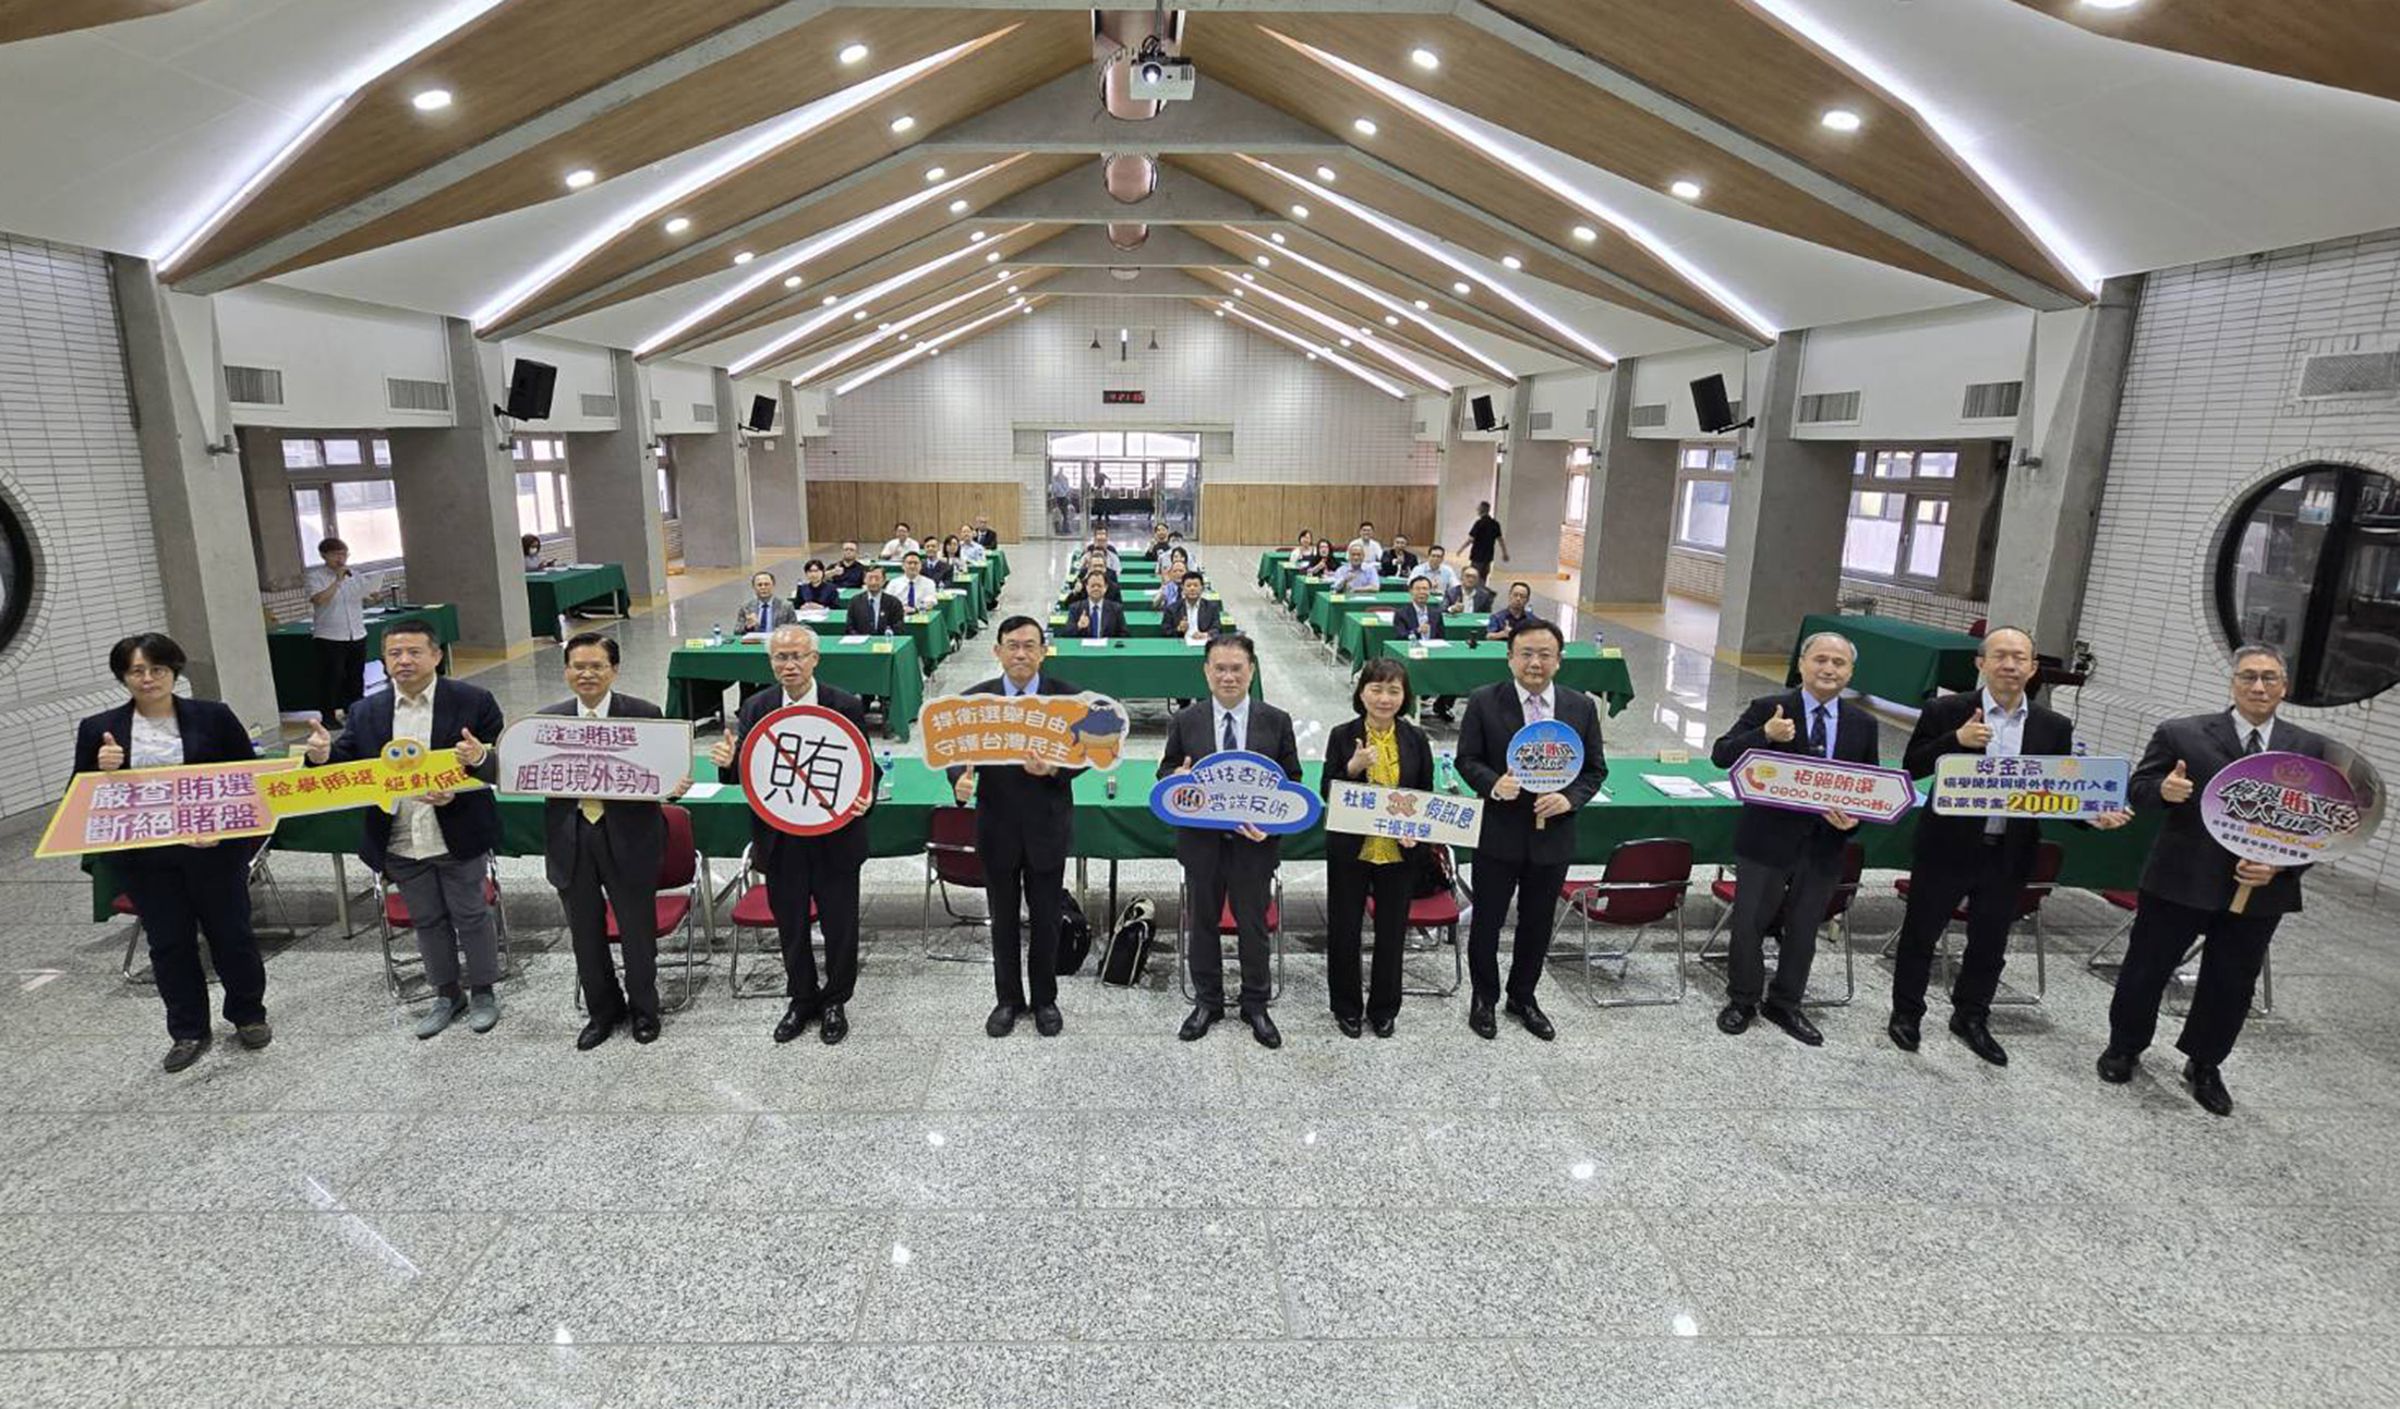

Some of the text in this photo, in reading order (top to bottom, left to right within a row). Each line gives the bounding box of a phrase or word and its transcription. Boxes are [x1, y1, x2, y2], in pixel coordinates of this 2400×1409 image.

[931, 704, 1068, 735] 捍衛選舉自由
[933, 732, 1072, 761] 守護台灣民主
[267, 768, 377, 797] 檢舉賄選
[515, 763, 661, 795] 阻絕境外勢力
[764, 732, 847, 811] 賄
[1794, 769, 1875, 794] 拒絕賄選
[90, 773, 257, 810] 嚴查賄選
[84, 803, 260, 843] 斷絕賭盤
[1342, 789, 1476, 830] 杜絕 假訊息
[1374, 818, 1432, 838] 干擾選舉
